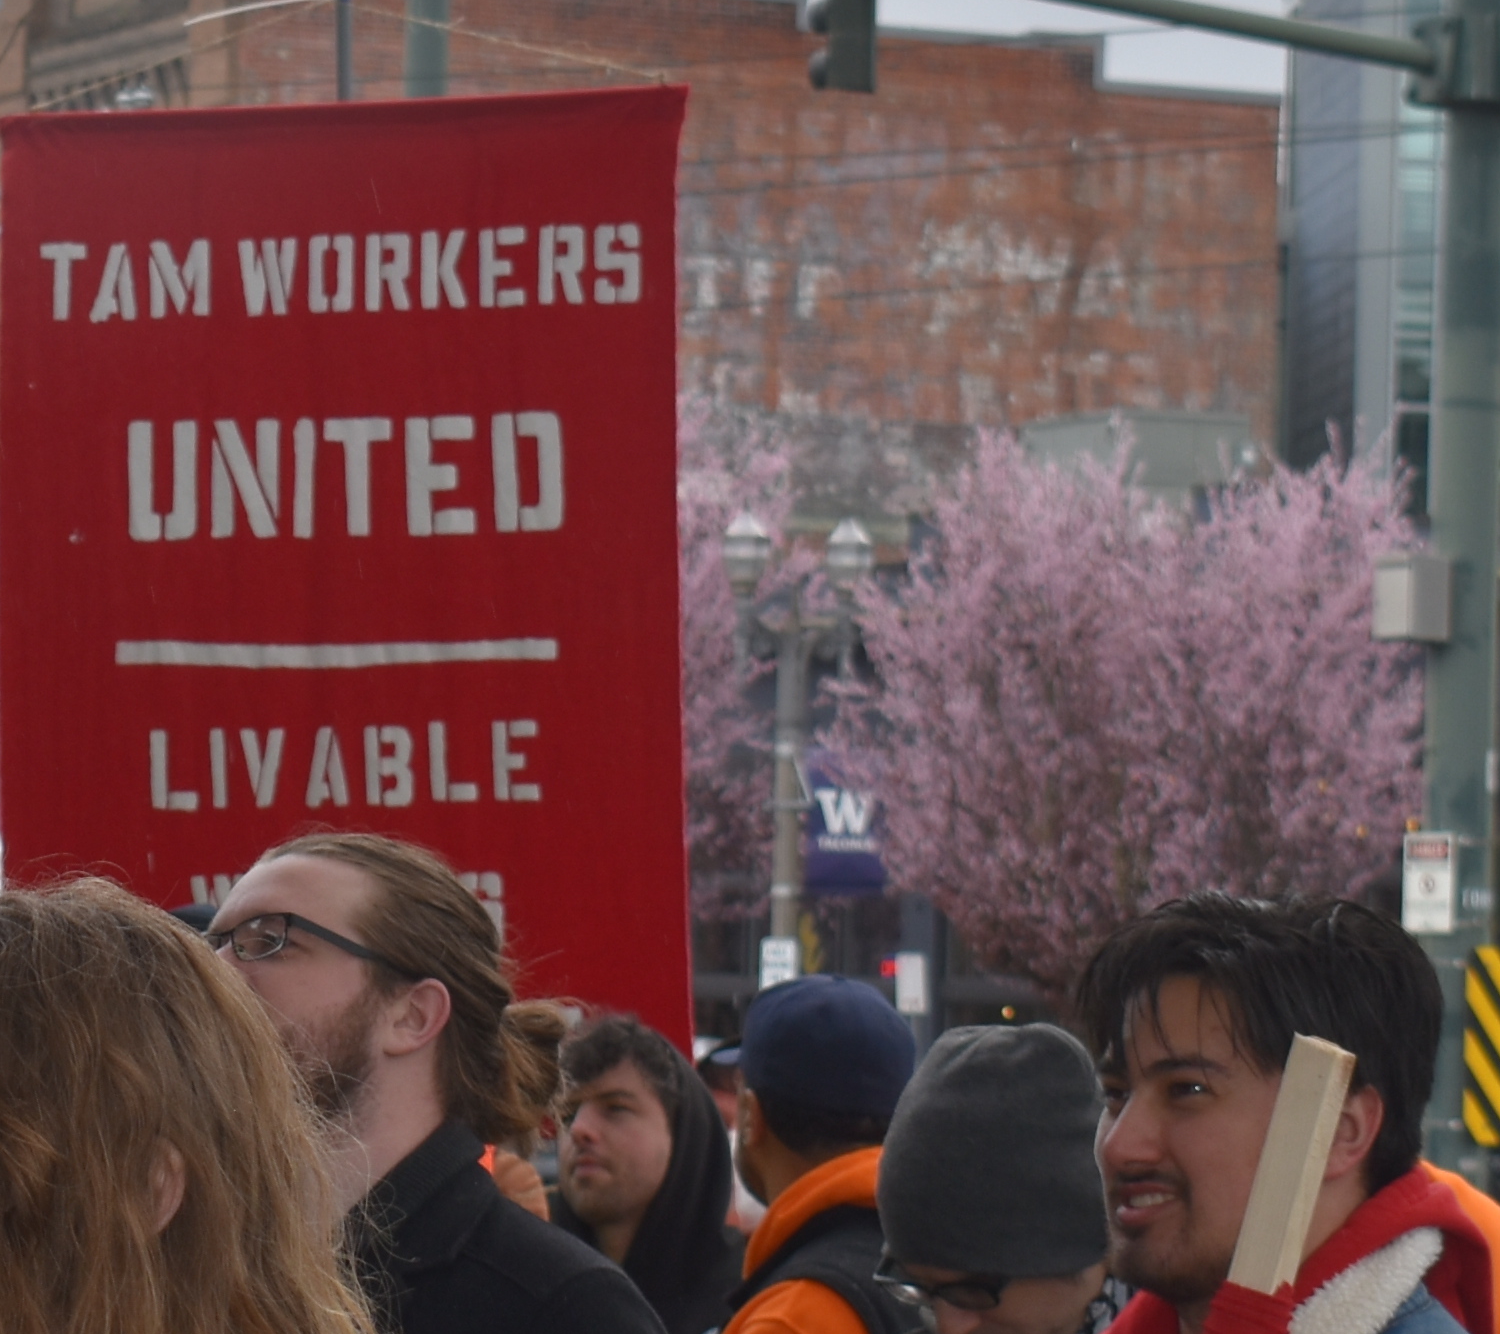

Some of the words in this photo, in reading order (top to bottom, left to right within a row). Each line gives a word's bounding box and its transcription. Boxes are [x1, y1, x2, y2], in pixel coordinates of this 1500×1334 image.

[40, 239, 211, 323] TAM
[237, 223, 643, 317] WORKERS
[127, 411, 565, 542] UNITED
[148, 720, 543, 811] LIVABLE
[814, 788, 877, 835] W
